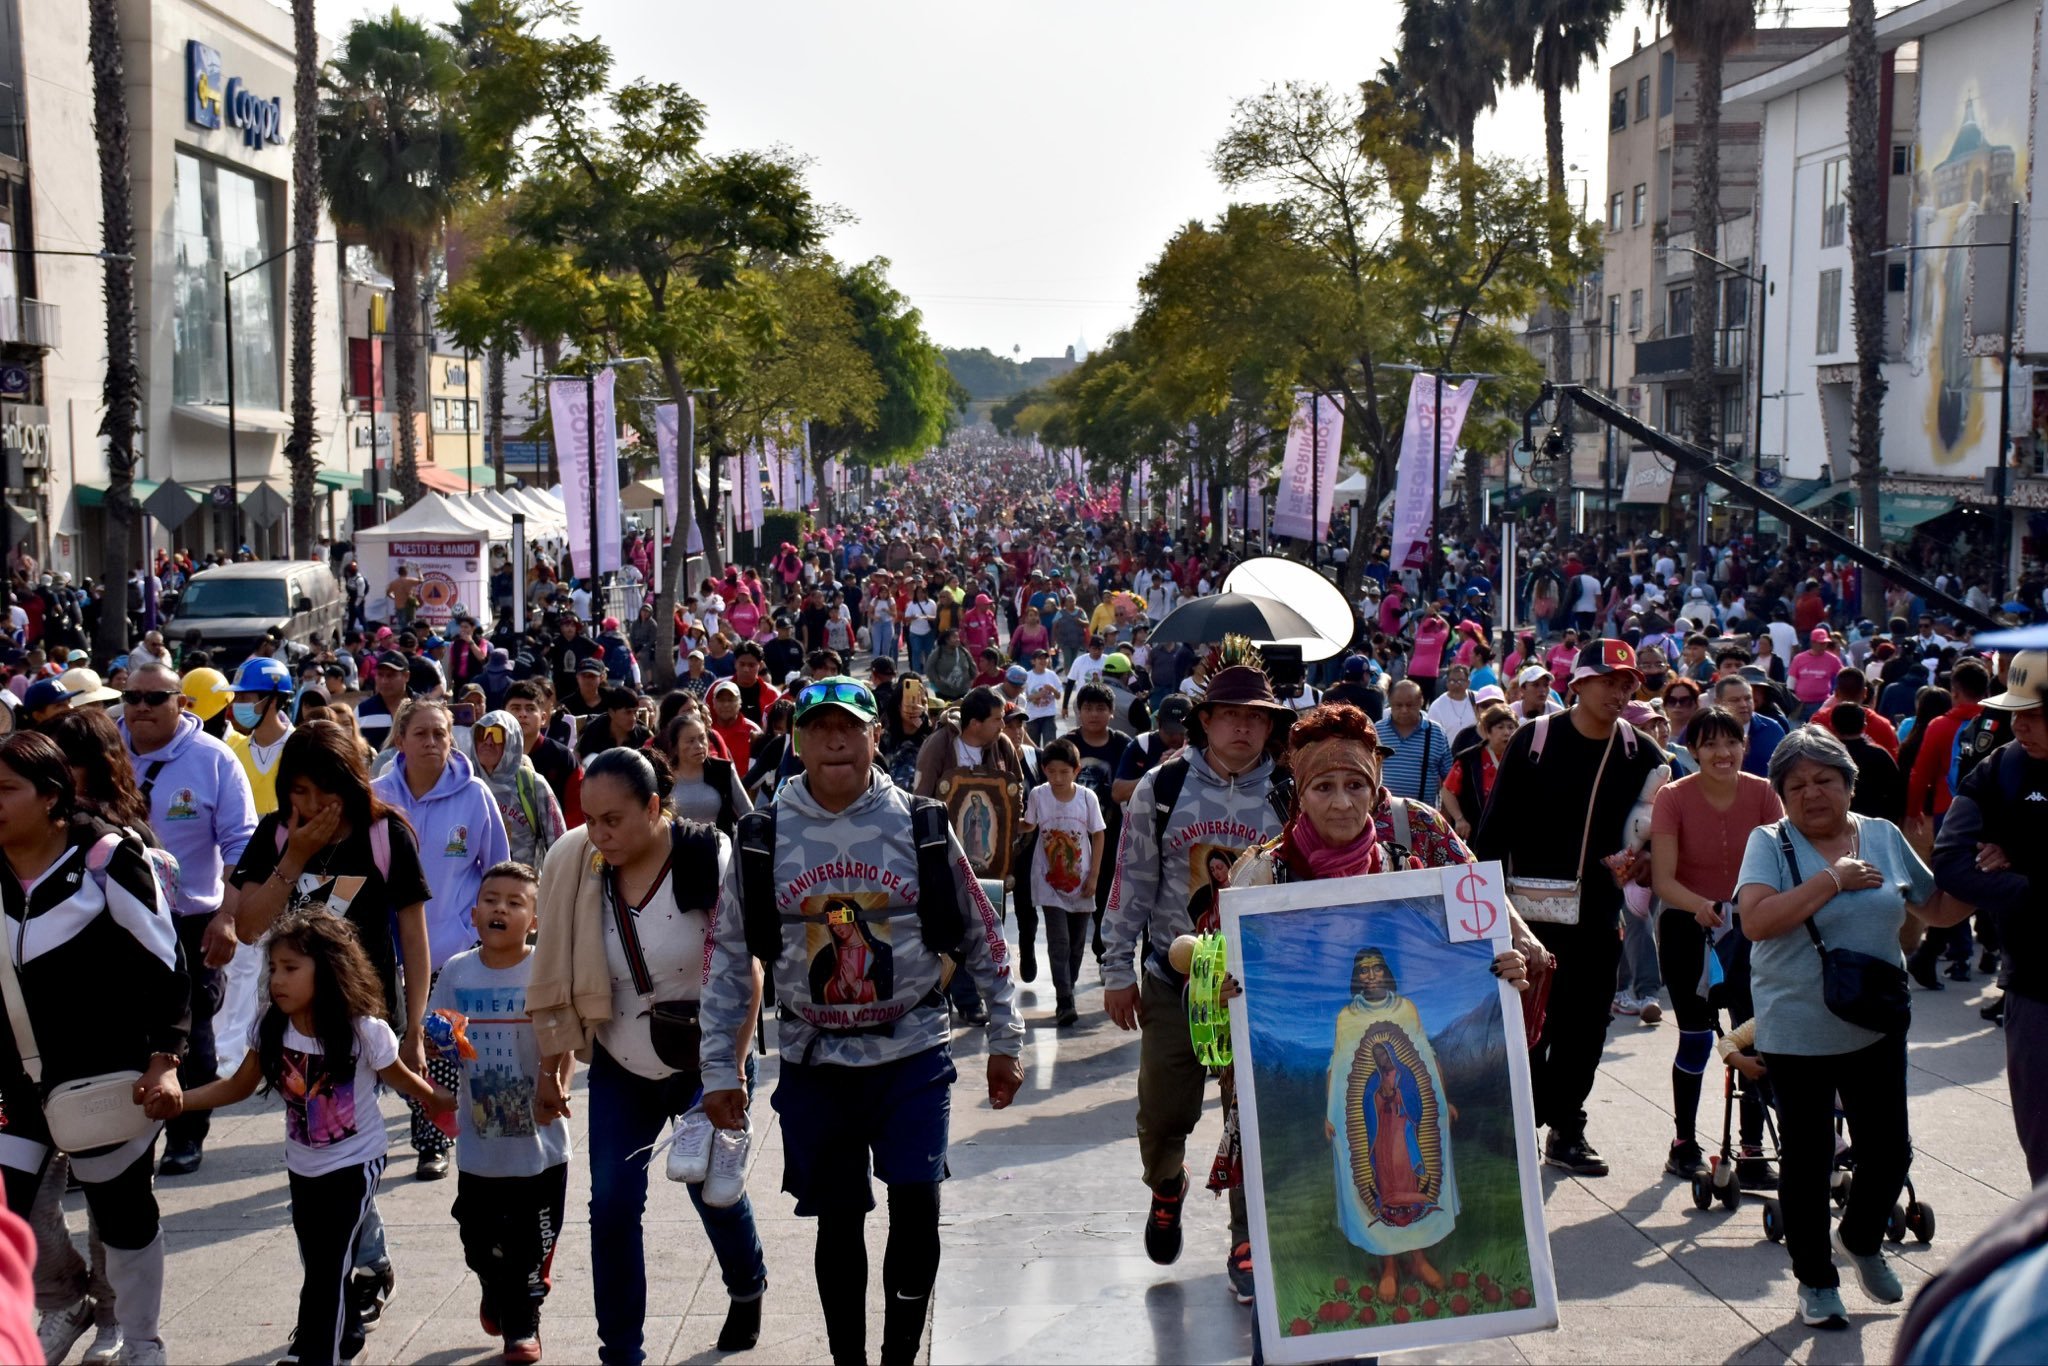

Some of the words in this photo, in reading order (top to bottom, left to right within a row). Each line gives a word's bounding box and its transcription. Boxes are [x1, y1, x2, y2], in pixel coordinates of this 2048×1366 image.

[225, 76, 285, 151] Coppel
[393, 543, 428, 554] PUESTO
[429, 544, 441, 555] DE
[443, 544, 476, 555] MANDO
[1169, 835, 1183, 851] 14
[1181, 820, 1257, 843] ANIVERSARIO
[1258, 833, 1268, 846] D
[777, 892, 792, 910] 14
[788, 861, 879, 899] ANIVERSARIO
[881, 870, 902, 891] DE
[900, 883, 917, 903] LA
[1456, 863, 1497, 939] $
[462, 999, 526, 1012] DREA
[802, 1007, 850, 1025] COLONIA
[852, 1003, 905, 1022] VCTORIA
[485, 1047, 513, 1057] THE
[475, 1063, 523, 1073] LIMI
[527, 1206, 556, 1285] Mrsport
